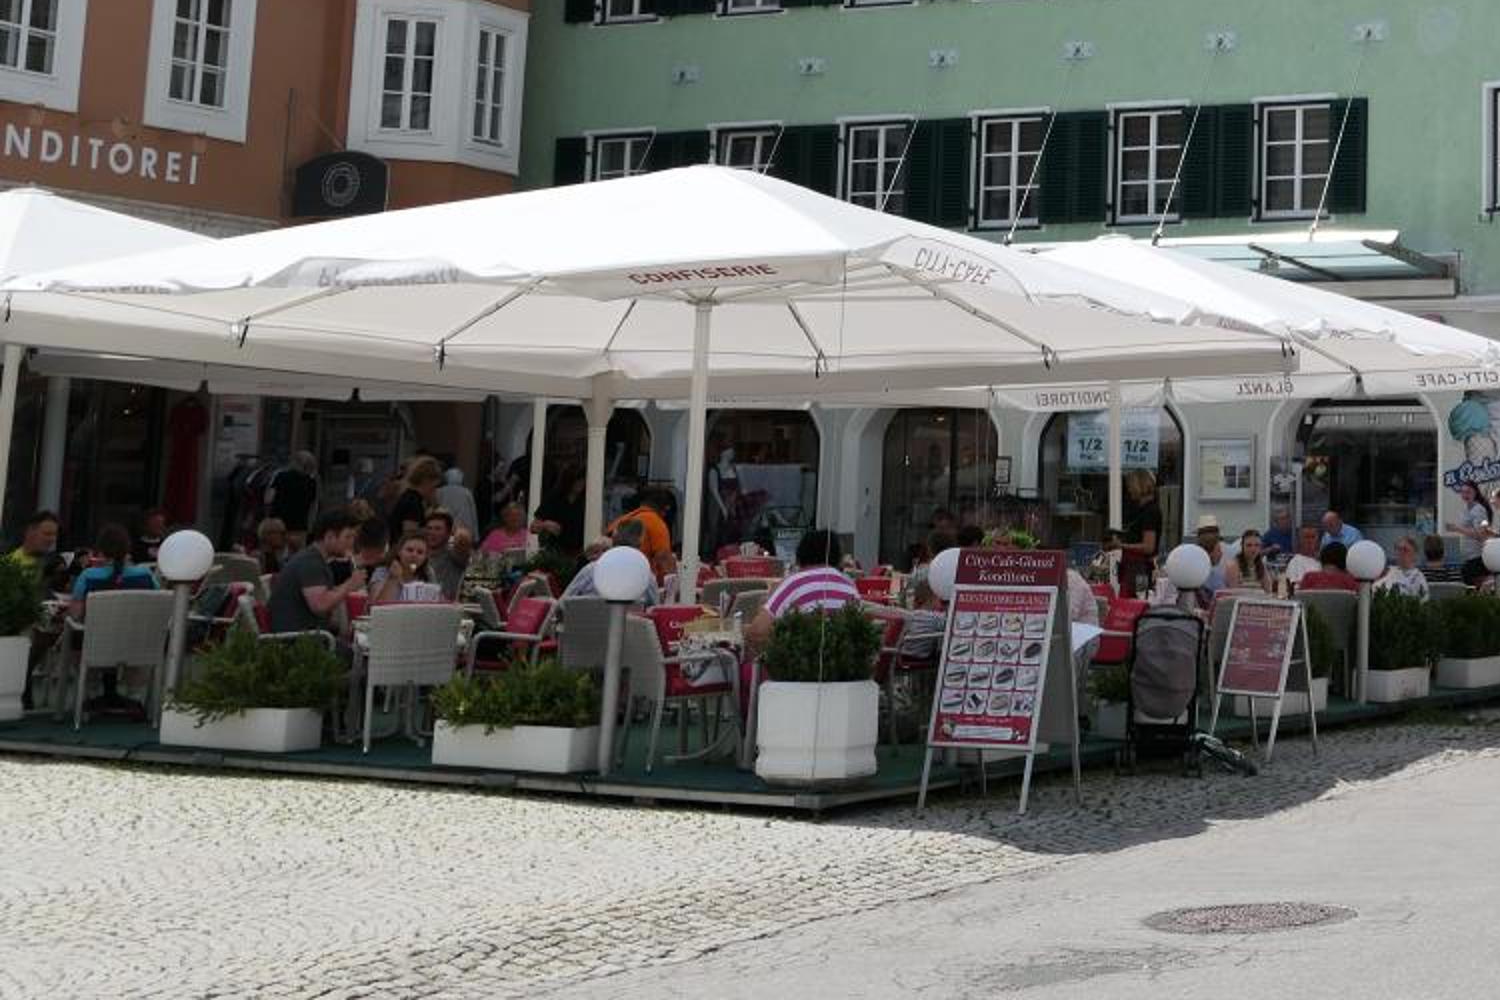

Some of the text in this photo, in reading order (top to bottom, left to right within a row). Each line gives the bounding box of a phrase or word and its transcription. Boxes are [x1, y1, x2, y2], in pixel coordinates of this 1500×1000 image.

[5, 122, 198, 185] NDITOREI
[629, 262, 779, 285] CONFISERIE
[1078, 438, 1103, 451] 1/2
[1122, 439, 1150, 453] 1/2
